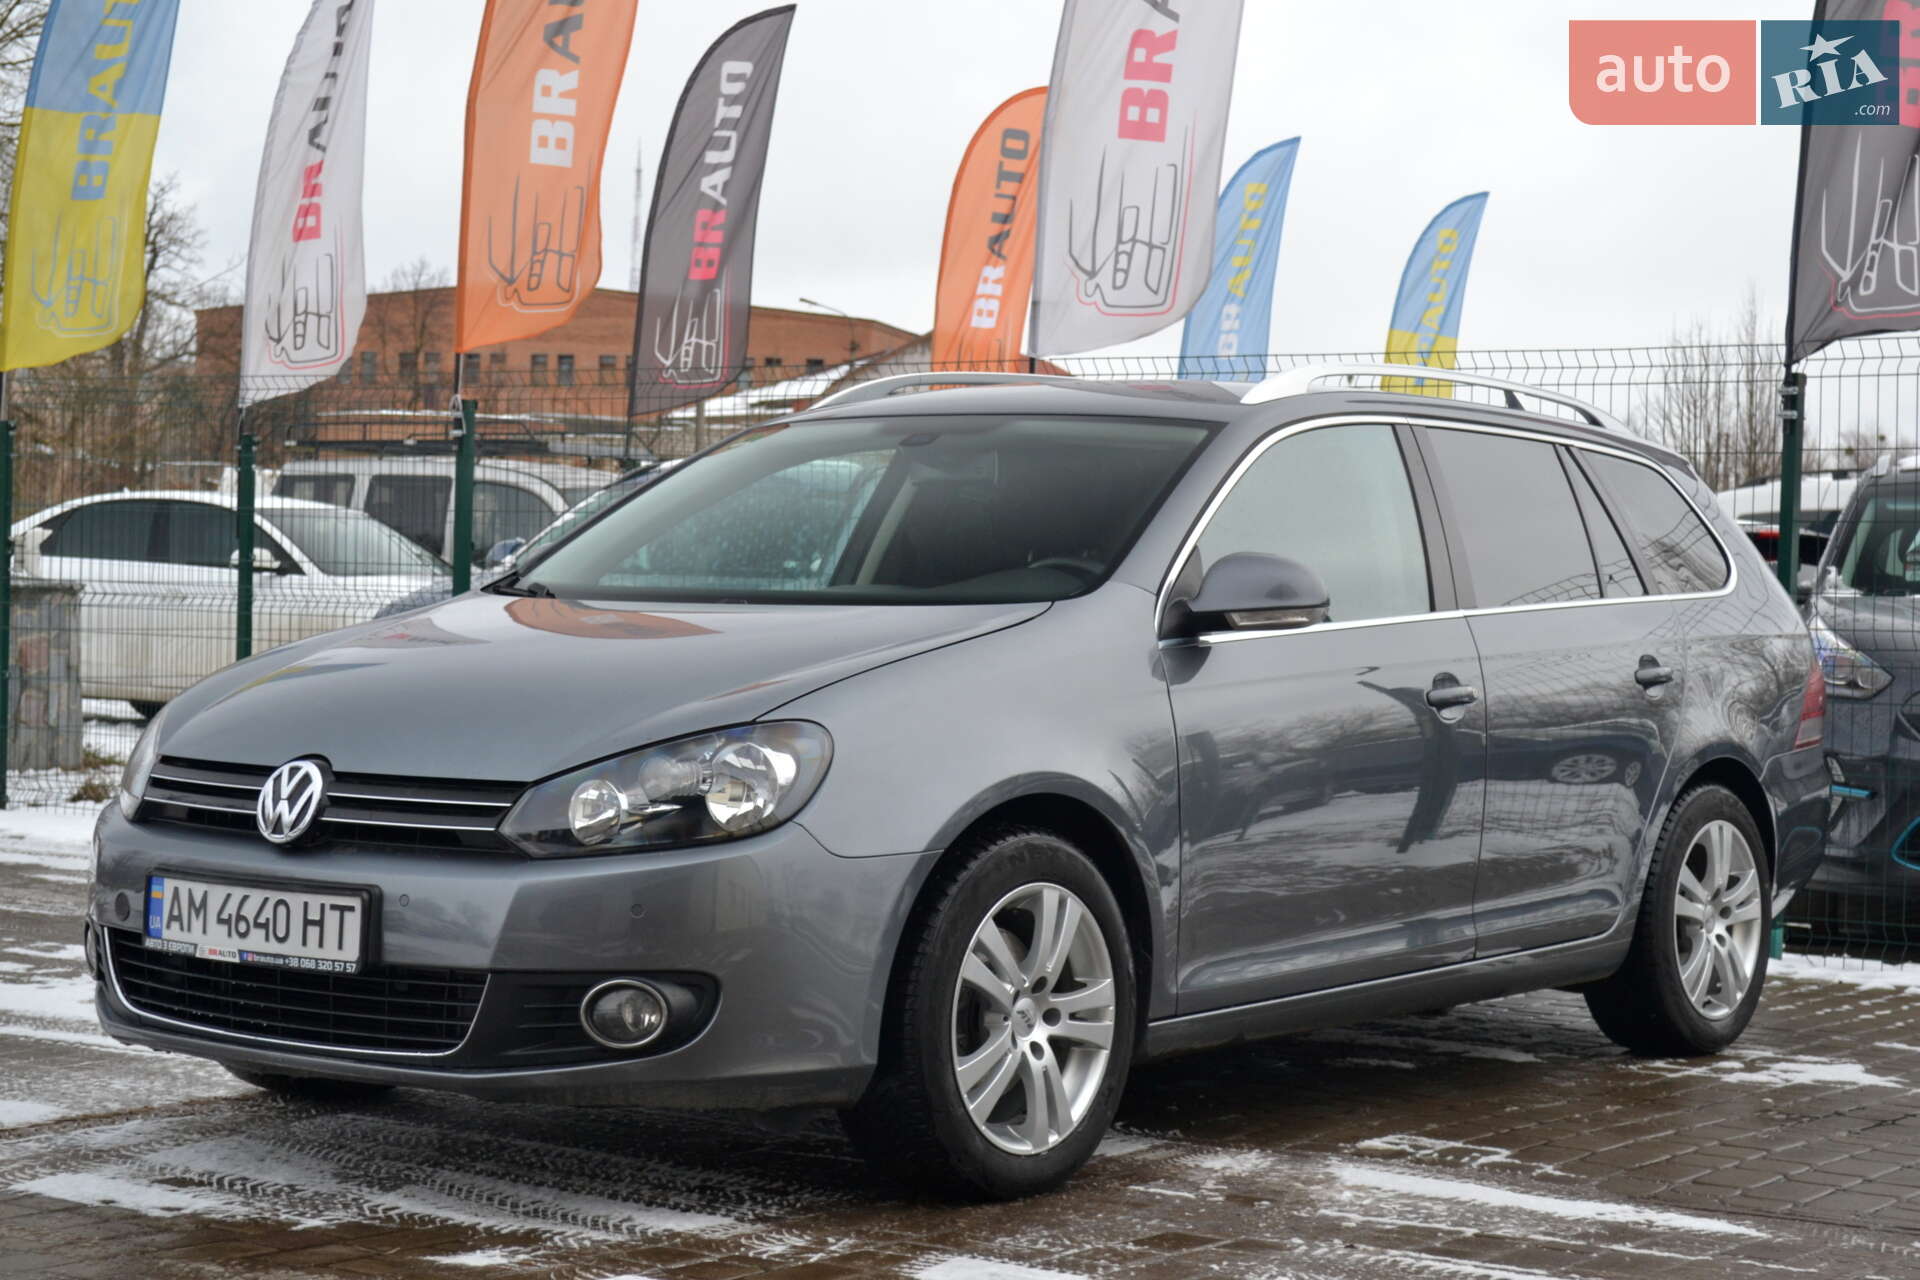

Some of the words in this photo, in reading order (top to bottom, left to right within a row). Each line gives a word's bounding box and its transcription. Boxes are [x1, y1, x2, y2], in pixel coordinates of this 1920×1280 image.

[529, 0, 585, 169] BRA
[688, 60, 754, 280] BRAUTO
[970, 128, 1030, 329] BRAUTO
[165, 886, 208, 935] AM
[216, 892, 291, 944] 4640
[301, 901, 356, 950] HT
